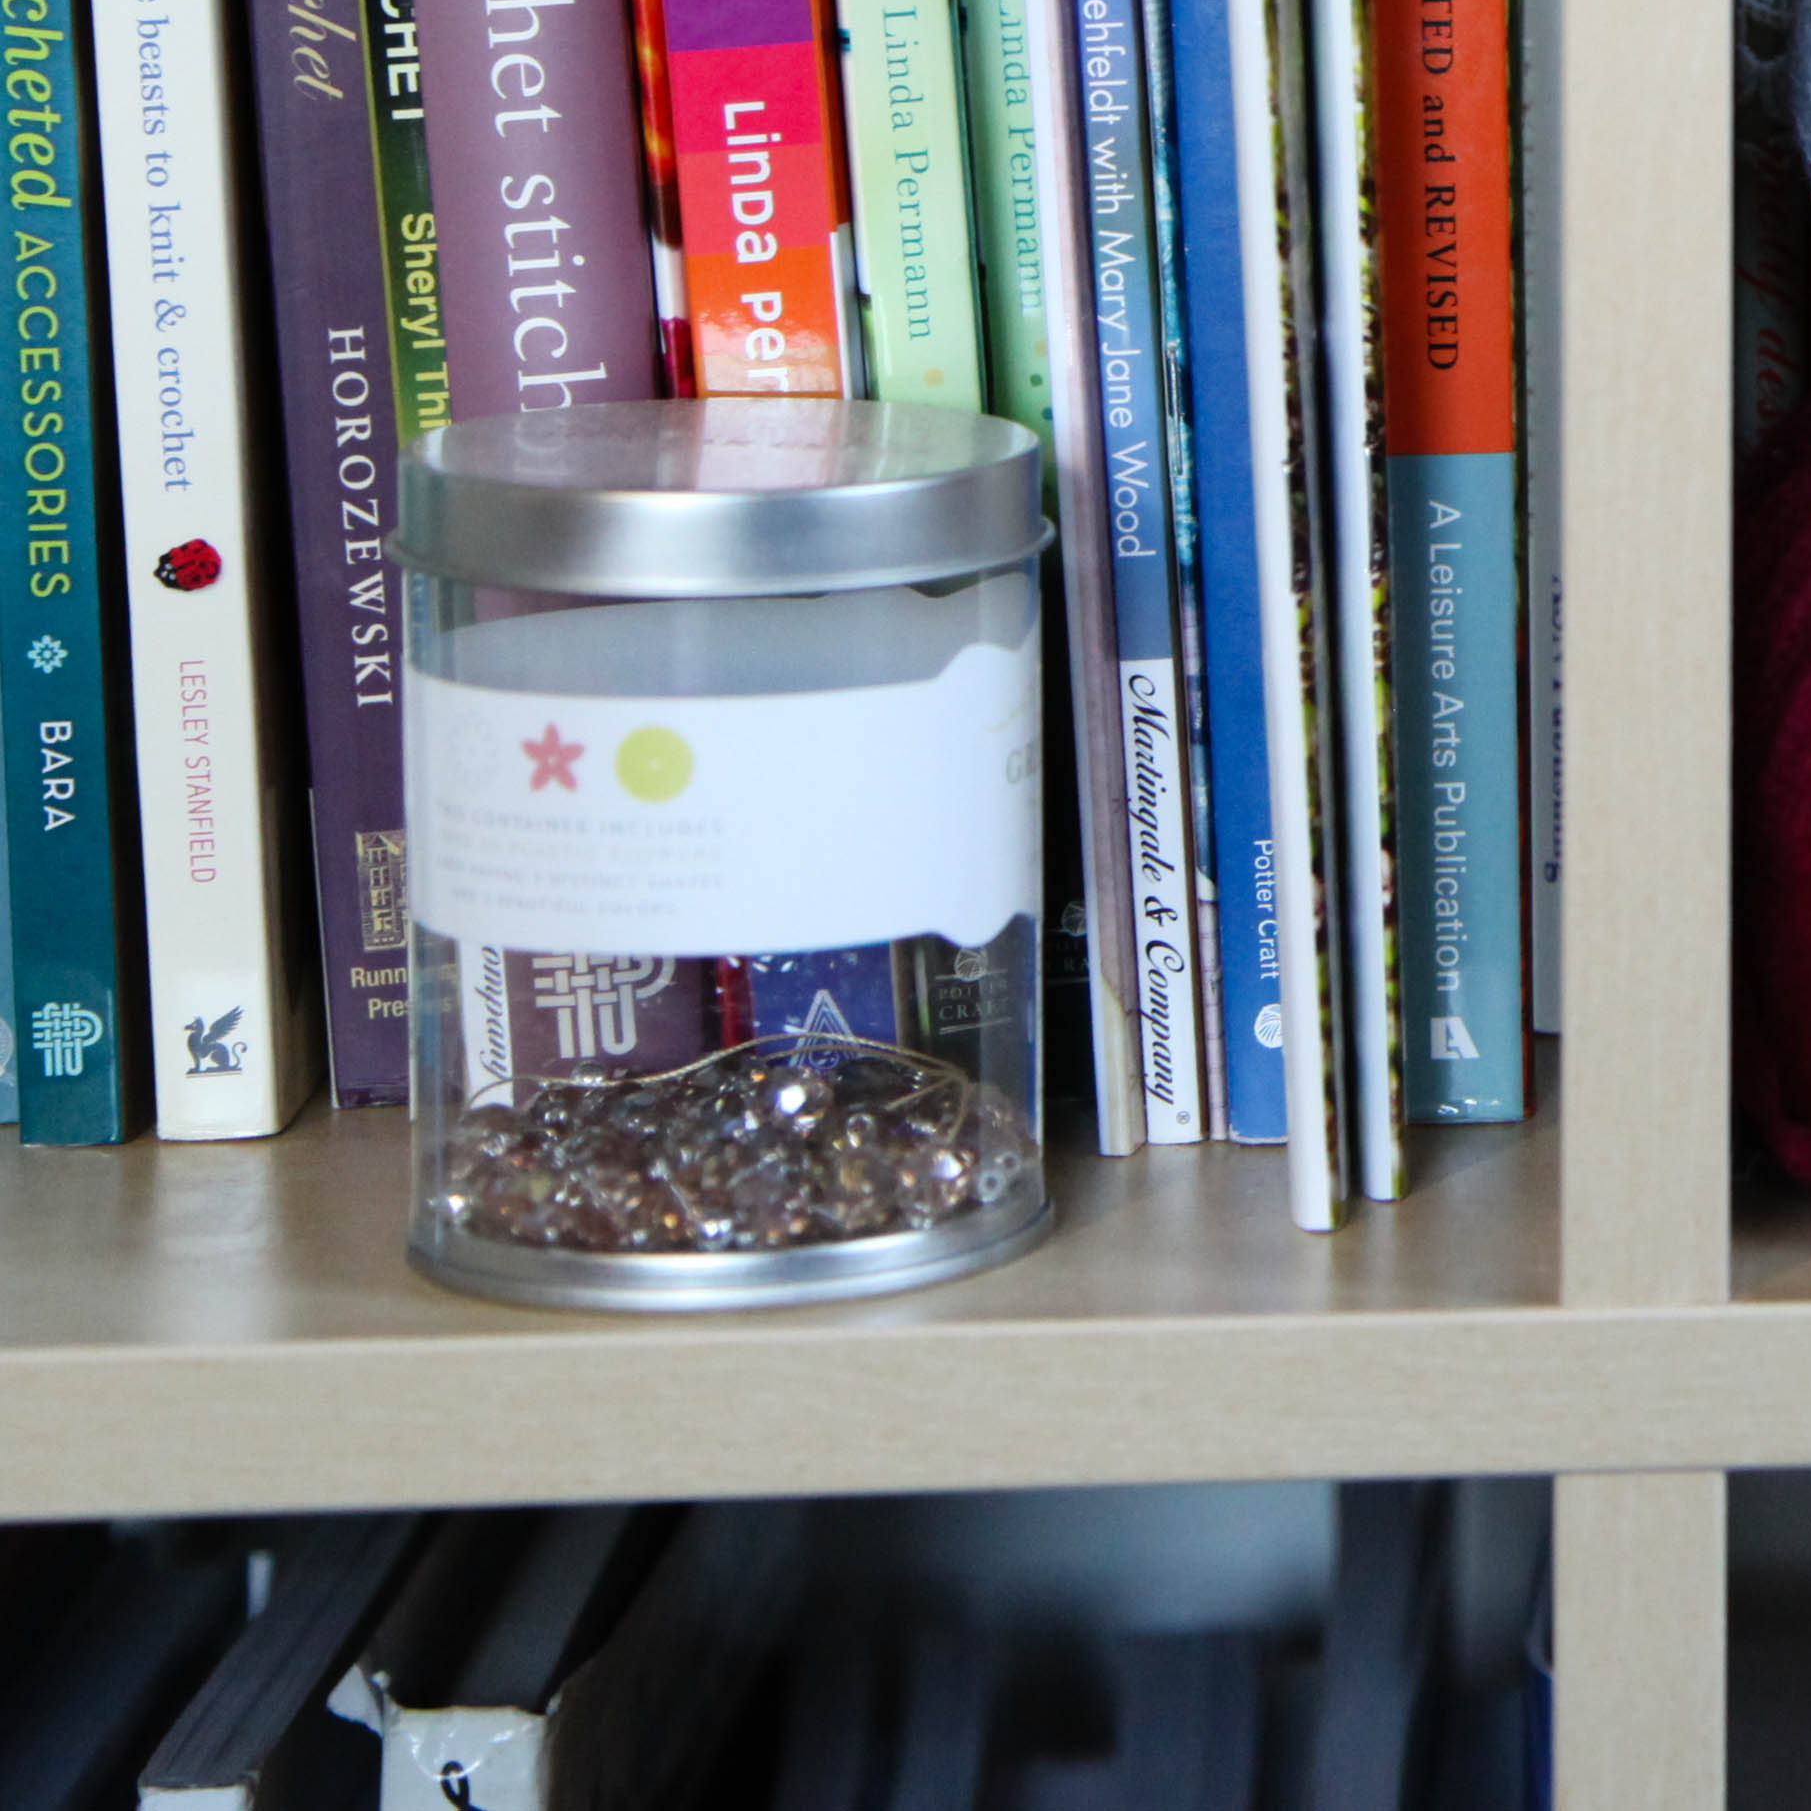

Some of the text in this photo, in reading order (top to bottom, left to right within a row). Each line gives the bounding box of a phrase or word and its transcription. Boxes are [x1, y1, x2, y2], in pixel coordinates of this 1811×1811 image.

[137, 18, 173, 140] beasts
[1423, 93, 1456, 166] and
[146, 148, 172, 187] to
[881, 5, 933, 342] Linda Permann
[1007, 121, 1044, 317] Permann
[1092, 138, 1136, 216] with
[148, 203, 183, 286] knit
[400, 212, 446, 349] Sheryl
[1096, 230, 1136, 329] Mary
[1424, 183, 1460, 373] REVISED
[153, 299, 187, 330] &
[13, 232, 72, 599] ACCESSORIES
[156, 349, 194, 493] crochet
[1101, 341, 1139, 430] Jane
[328, 326, 394, 710] HOROZEWSKI
[1109, 442, 1156, 559] Wood
[39, 722, 76, 833] BARA
[179, 660, 218, 886] LESLEY STANFIELD
[1429, 500, 1470, 995] A Leisure Arts Publication
[1126, 672, 1187, 1107] Martingale & Company
[1253, 838, 1279, 915] Potter
